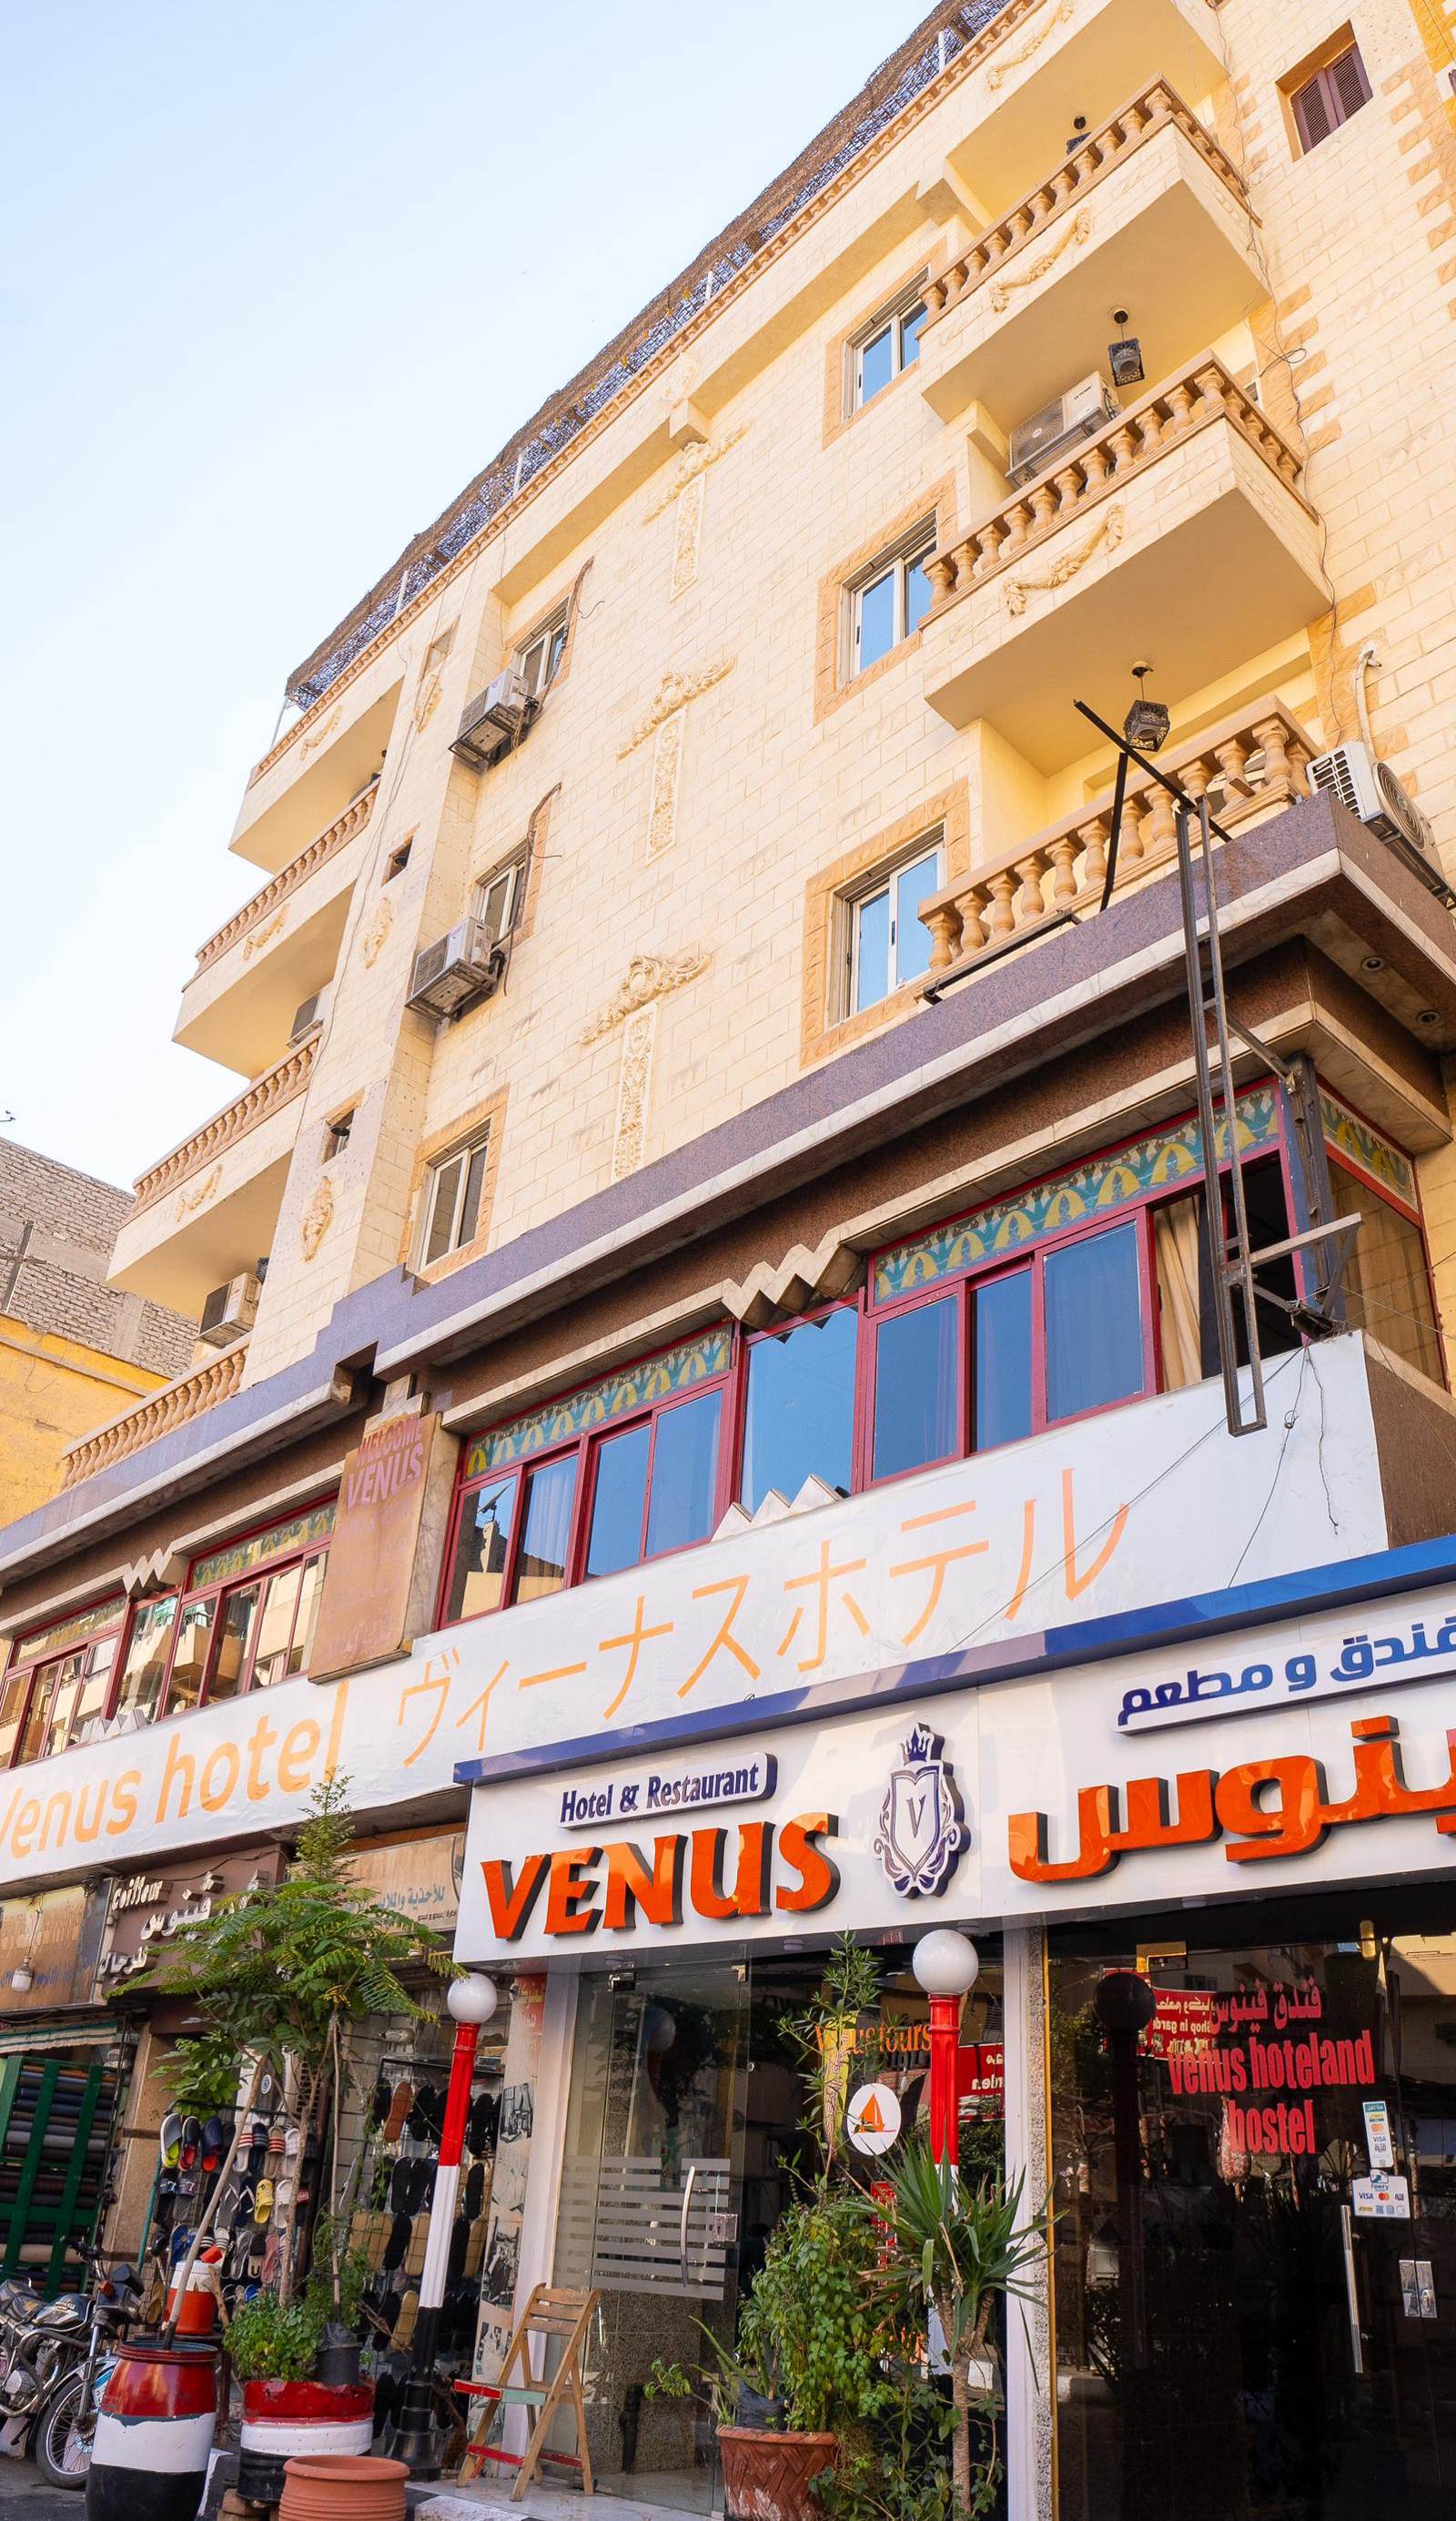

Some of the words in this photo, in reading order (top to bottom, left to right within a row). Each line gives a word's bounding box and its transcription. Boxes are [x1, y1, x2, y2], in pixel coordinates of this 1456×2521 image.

[356, 1417, 423, 1466] WELCOME
[347, 1443, 425, 1511] VENUS
[398, 1467, 1131, 1768] ヴィーナスホテル
[1117, 1664, 1274, 1726] مطعم
[1285, 1654, 1317, 1692] و
[155, 1679, 350, 1824] hotel
[560, 1783, 614, 1823] Hotel
[619, 1783, 640, 1813] &
[646, 1762, 761, 1809] Restaurant
[906, 1793, 926, 1838] V
[480, 1811, 842, 1940] VENUS
